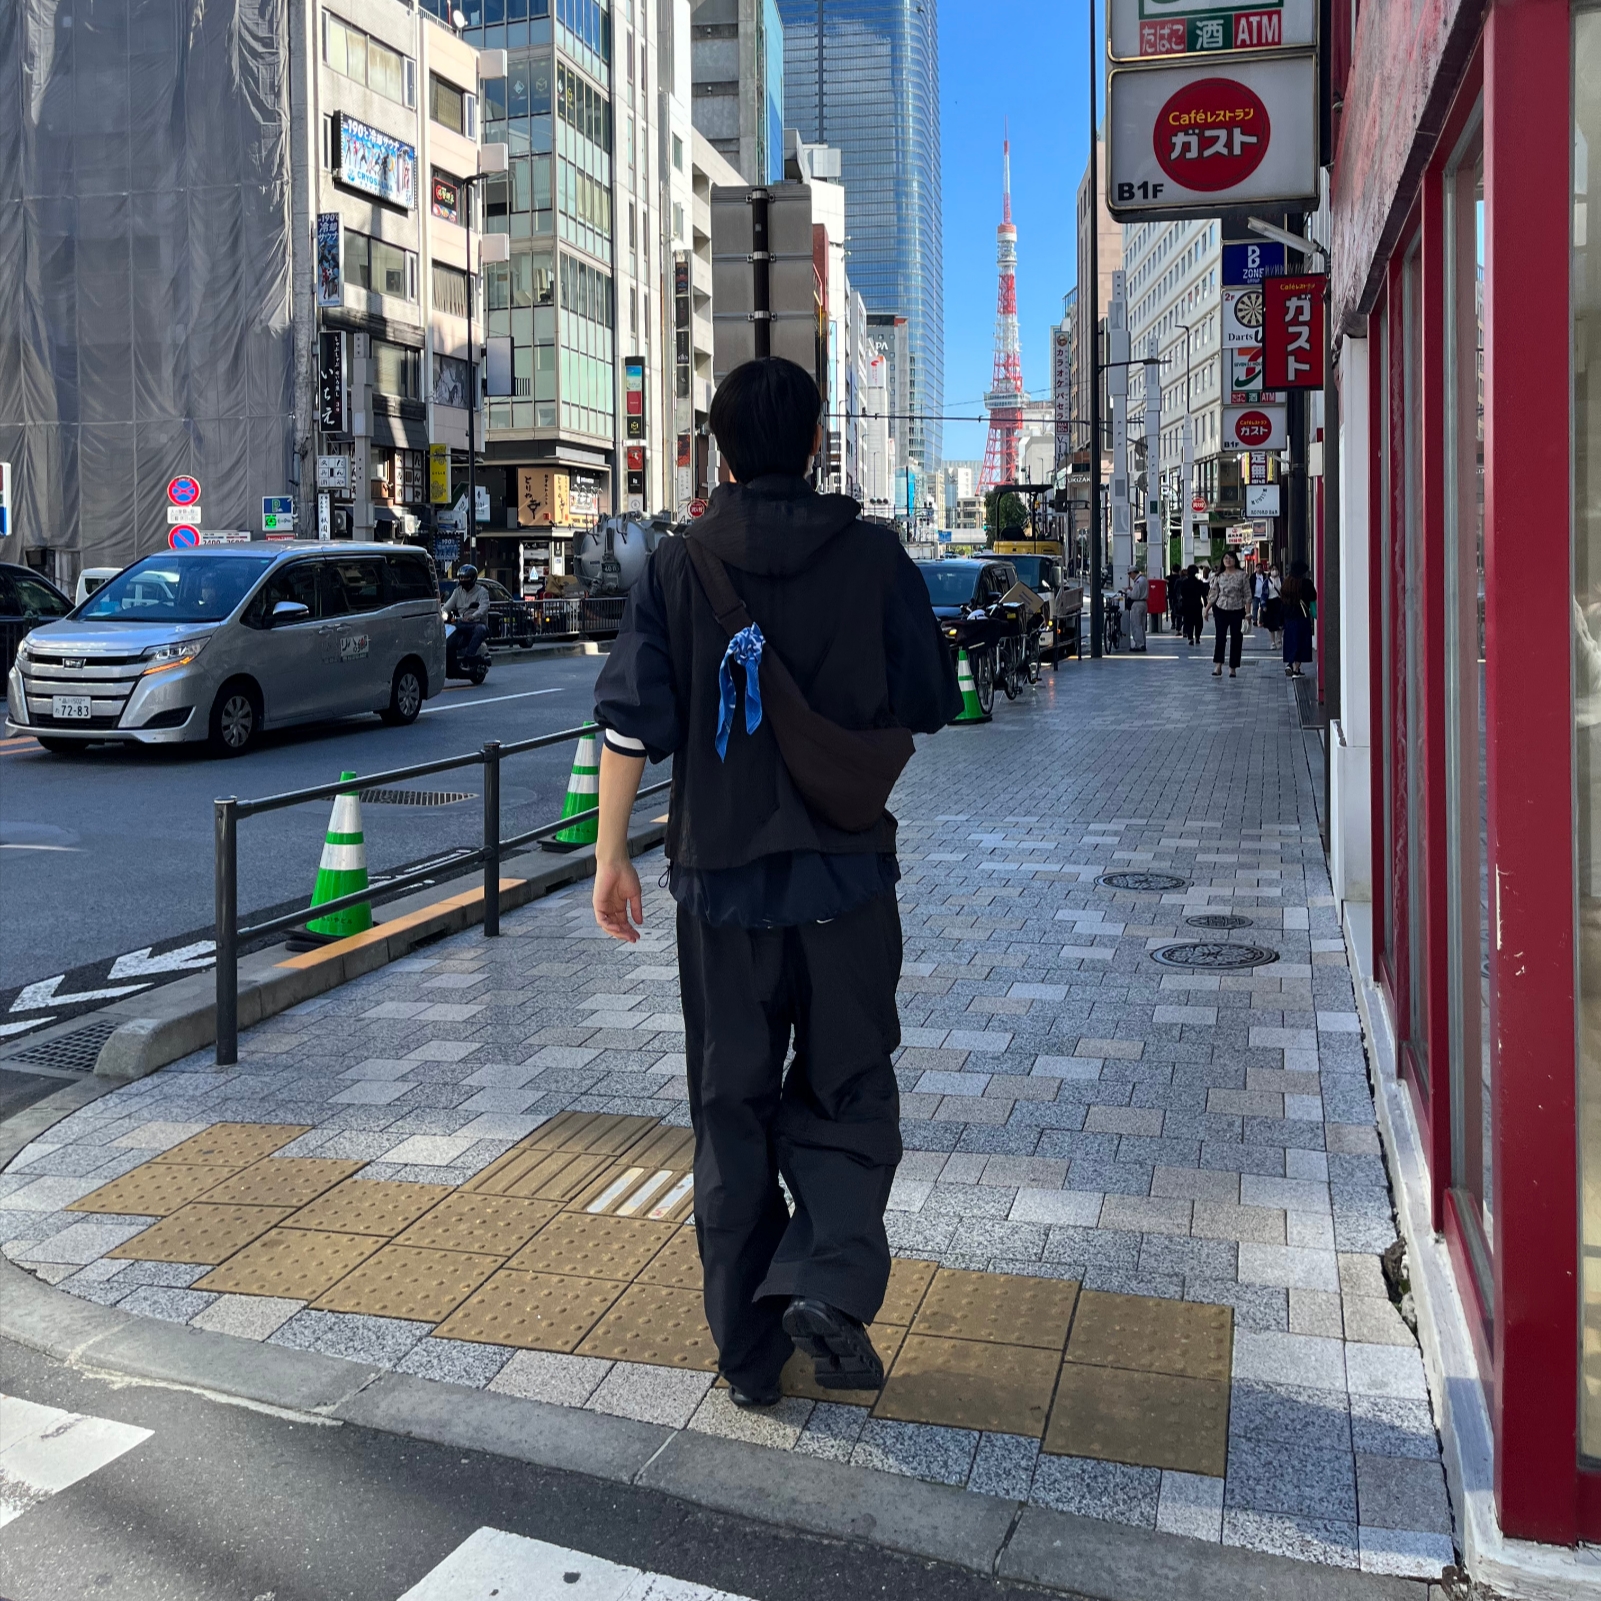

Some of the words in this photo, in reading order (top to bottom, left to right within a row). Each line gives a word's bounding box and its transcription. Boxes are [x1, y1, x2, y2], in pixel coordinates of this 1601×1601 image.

[1142, 24, 1184, 53] たばこ
[1196, 19, 1224, 49] 酒
[1236, 14, 1279, 46] ATM
[1170, 127, 1258, 160] ガスト
[1117, 181, 1164, 201] B1F
[1224, 293, 1235, 301] 2F
[1228, 333, 1253, 341] Darts
[1284, 294, 1311, 381] ガスト
[321, 368, 335, 425] いちえ
[1261, 392, 1275, 402] ATM
[1241, 426, 1268, 436] ガスト
[61, 705, 89, 717] 72-83
